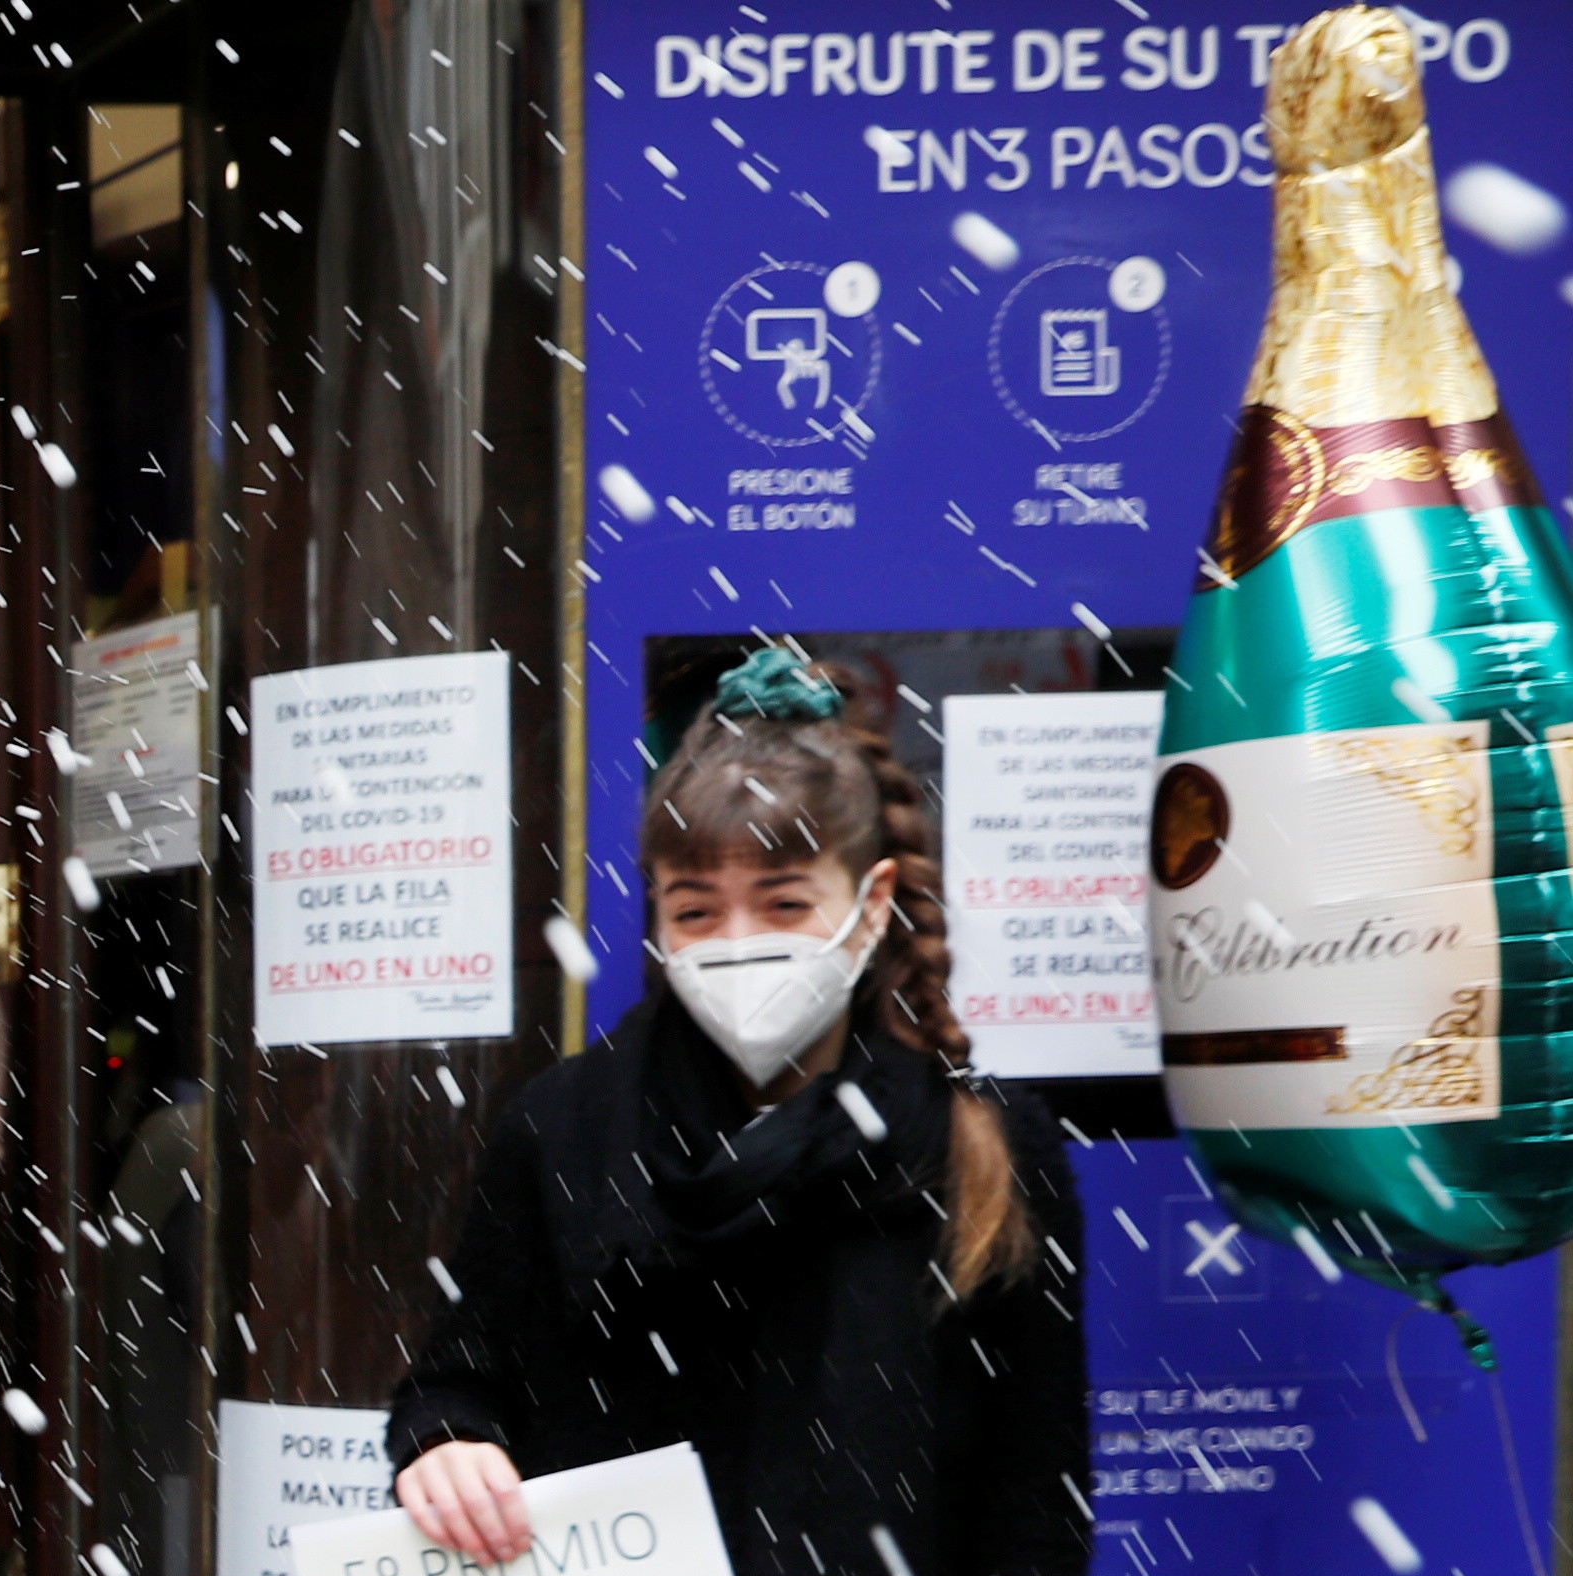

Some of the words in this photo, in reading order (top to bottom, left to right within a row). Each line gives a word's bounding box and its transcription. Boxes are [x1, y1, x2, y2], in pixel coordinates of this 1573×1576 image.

[653, 28, 996, 98] DISFRUTE
[1012, 28, 1104, 92] DE
[1122, 25, 1219, 92] SU
[1234, 18, 1511, 88] TPO
[877, 130, 965, 195] EN
[985, 126, 1030, 191] 3
[1051, 121, 1278, 190] PASOS
[727, 466, 854, 496] PRESIONE
[1035, 462, 1124, 491] RETIRE
[727, 506, 760, 532] EL
[763, 498, 856, 532] BOTÓN
[1012, 499, 1051, 527] SU
[1054, 496, 1147, 527] TURNO
[275, 702, 299, 723] EN
[303, 686, 475, 718] CUMPLIMIENTO
[291, 731, 313, 749] DE
[319, 726, 352, 745] LAS
[357, 717, 454, 740] MEDIDAS
[313, 747, 429, 770] NITARIAS
[300, 812, 336, 833] DEL
[340, 804, 445, 830] COVID-19
[970, 812, 1022, 831] PARA
[267, 850, 293, 874] ES
[298, 836, 492, 871] OBLIGATORIO
[1007, 842, 1046, 863] DEL
[297, 884, 347, 910] QUE
[355, 882, 386, 905] LA
[395, 878, 451, 902] FILA
[965, 877, 996, 901] ES
[304, 922, 331, 946] SE
[338, 915, 443, 942] REALICE
[1002, 915, 1057, 941] QUE
[1065, 915, 1096, 938] LA
[268, 962, 298, 988] DE
[304, 958, 367, 985] UNO
[375, 956, 412, 981] EN
[423, 953, 493, 978] UNO
[1010, 953, 1038, 978] SE
[1047, 952, 1151, 976] REALICE
[965, 993, 1000, 1017] DE
[1008, 992, 1076, 1017] UNO
[1083, 991, 1120, 1016] EN
[1278, 1387, 1302, 1411] Y
[281, 1433, 334, 1460] POR
[1201, 1424, 1316, 1452] CUANDO
[1143, 1467, 1183, 1494] SU
[1184, 1465, 1276, 1493] TURNO
